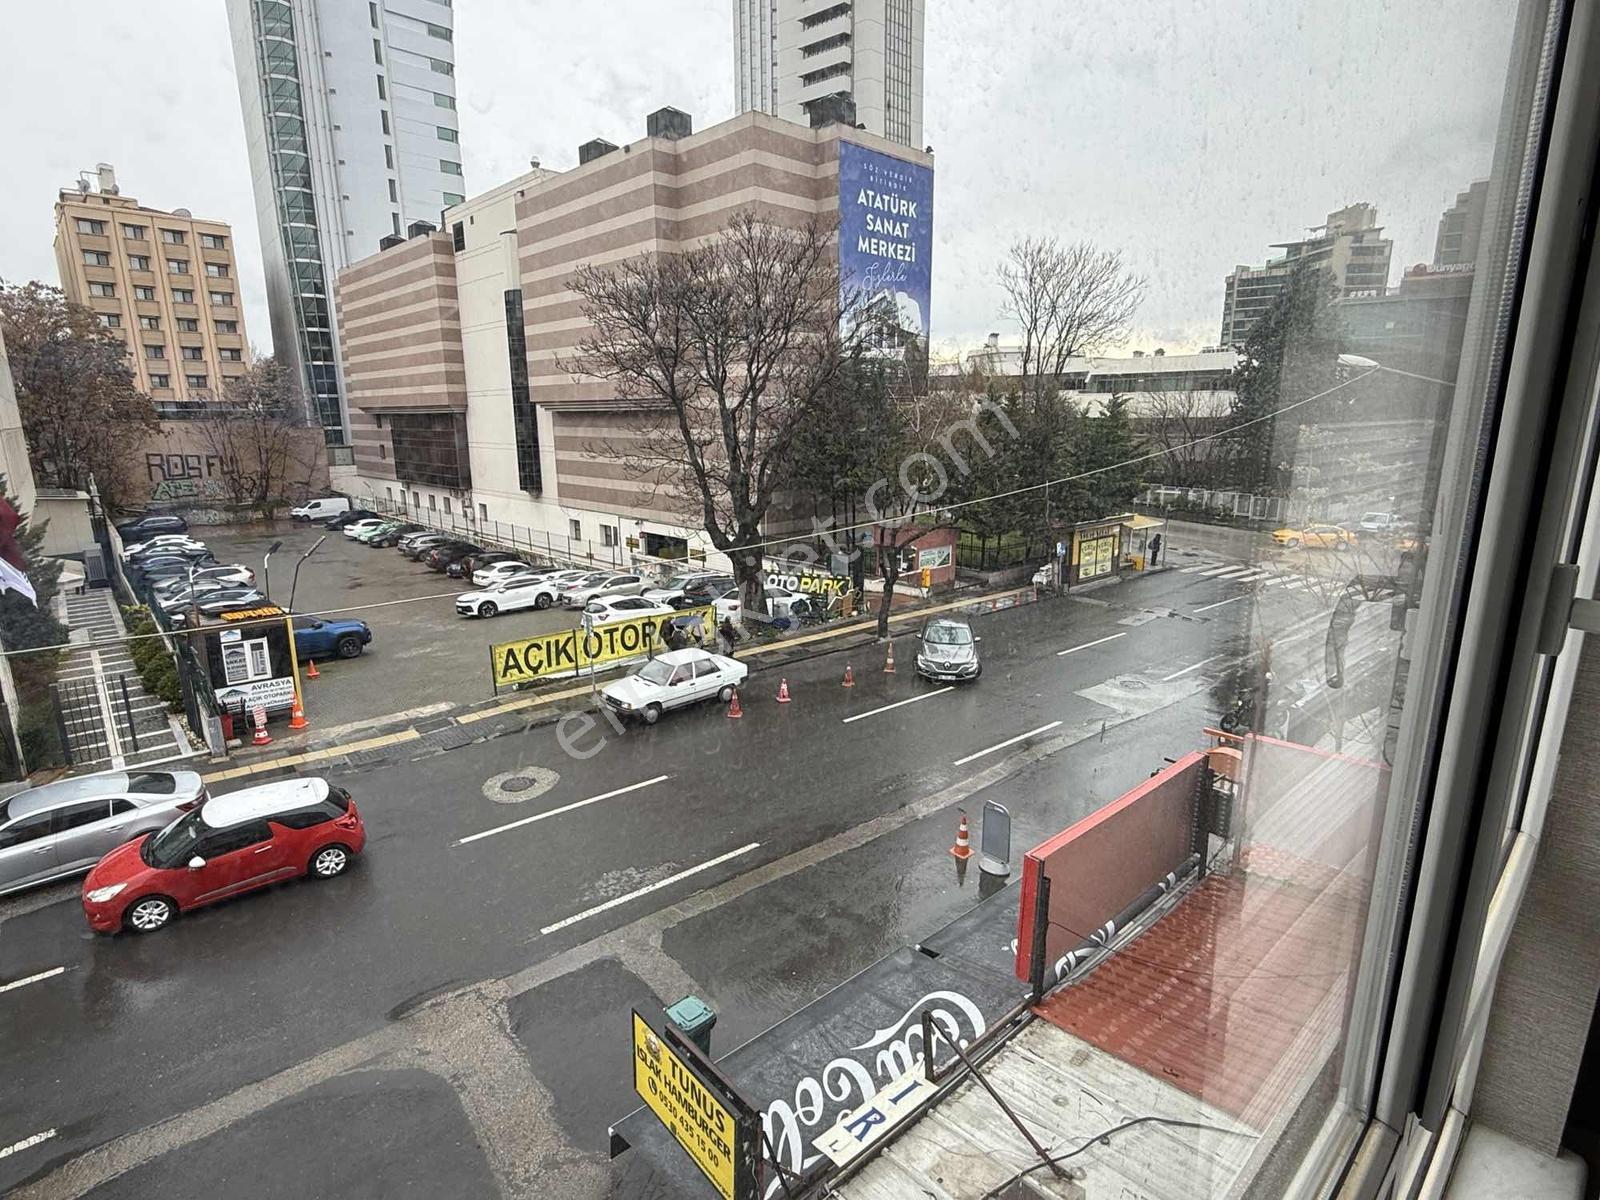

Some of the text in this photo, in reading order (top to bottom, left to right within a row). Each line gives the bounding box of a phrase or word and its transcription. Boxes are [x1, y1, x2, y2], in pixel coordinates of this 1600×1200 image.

[857, 188, 918, 219] ATATÜRK
[866, 214, 909, 239] SANAT
[857, 235, 916, 263] MERKEZİ
[502, 610, 709, 678] AÇIK OTOP
[251, 679, 293, 692] AVRASYA
[664, 1074, 732, 1163] HAMBURGER
[668, 1056, 725, 1134] TUNUS
[658, 1090, 678, 1119] 0530
[696, 1134, 706, 1153] 15
[708, 1148, 719, 1168] 00
